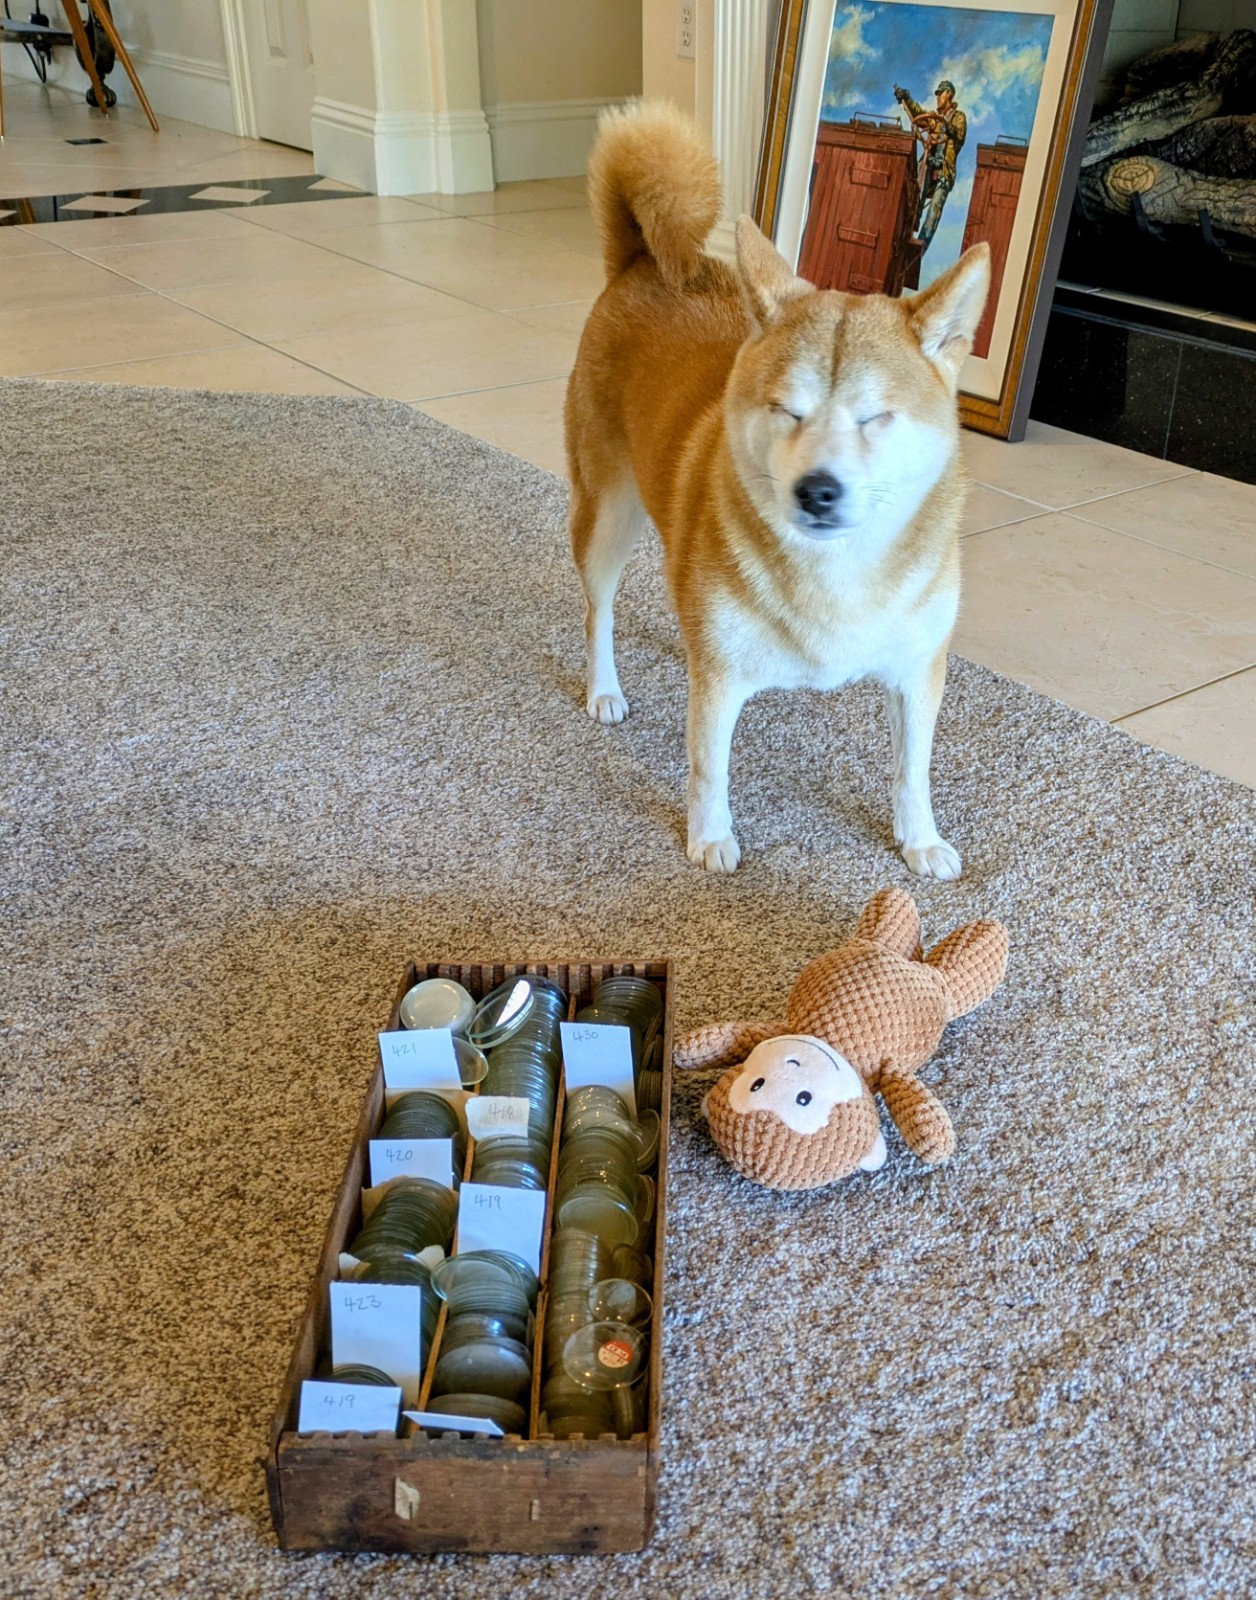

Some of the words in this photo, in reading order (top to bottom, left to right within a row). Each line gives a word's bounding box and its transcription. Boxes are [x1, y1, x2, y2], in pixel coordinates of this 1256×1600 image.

[573, 1030, 599, 1042] 430
[392, 1042, 417, 1057] 421
[386, 1148, 413, 1162] 420
[474, 1193, 501, 1209] 419
[344, 1294, 382, 1311] 423
[324, 1394, 356, 1407] 419
